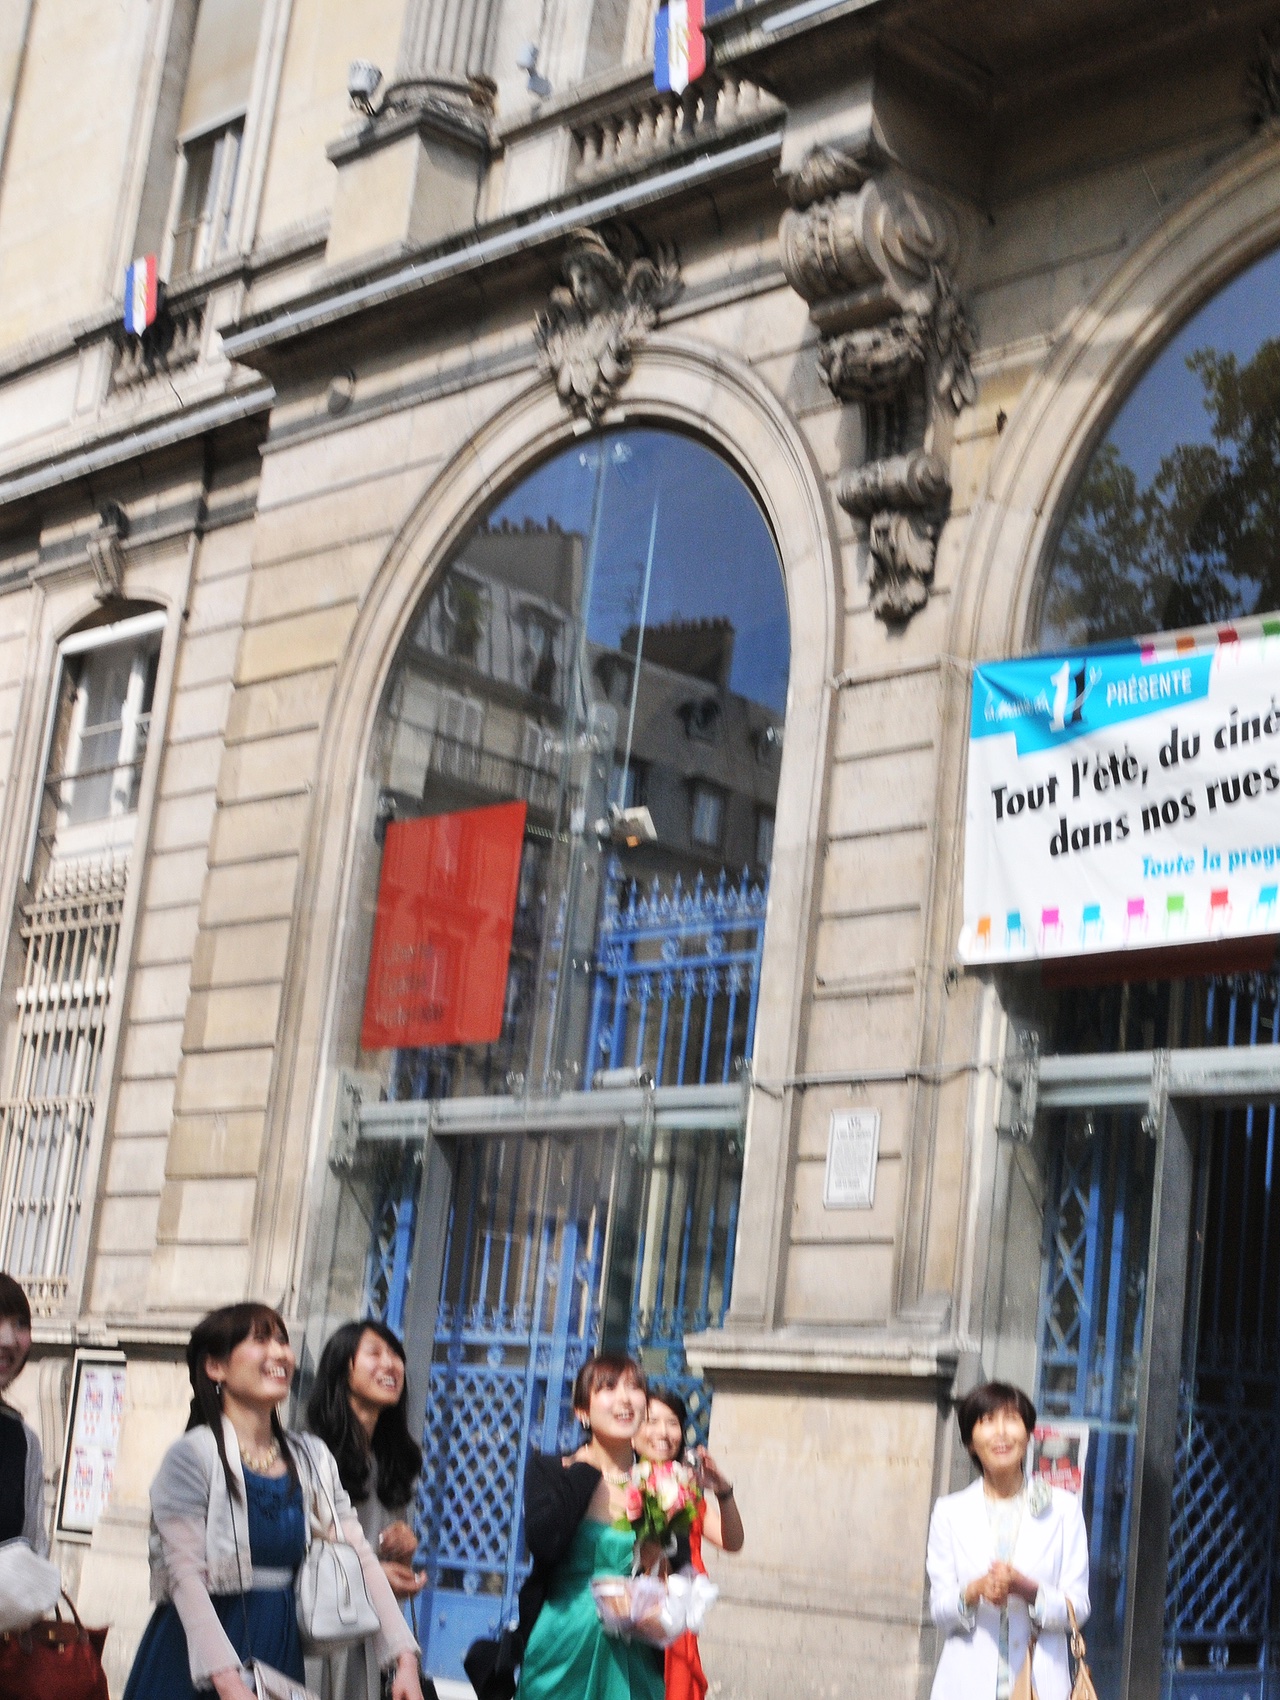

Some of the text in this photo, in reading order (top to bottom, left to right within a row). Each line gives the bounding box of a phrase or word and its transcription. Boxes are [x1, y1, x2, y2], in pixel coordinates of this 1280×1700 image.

[1106, 667, 1192, 708] PRÉSENTE
[991, 772, 1058, 821] Tout
[1158, 723, 1200, 770] du
[1050, 813, 1131, 857] dans
[1141, 791, 1197, 835] nos
[1142, 852, 1196, 879] Toute
[1201, 846, 1223, 872] la
